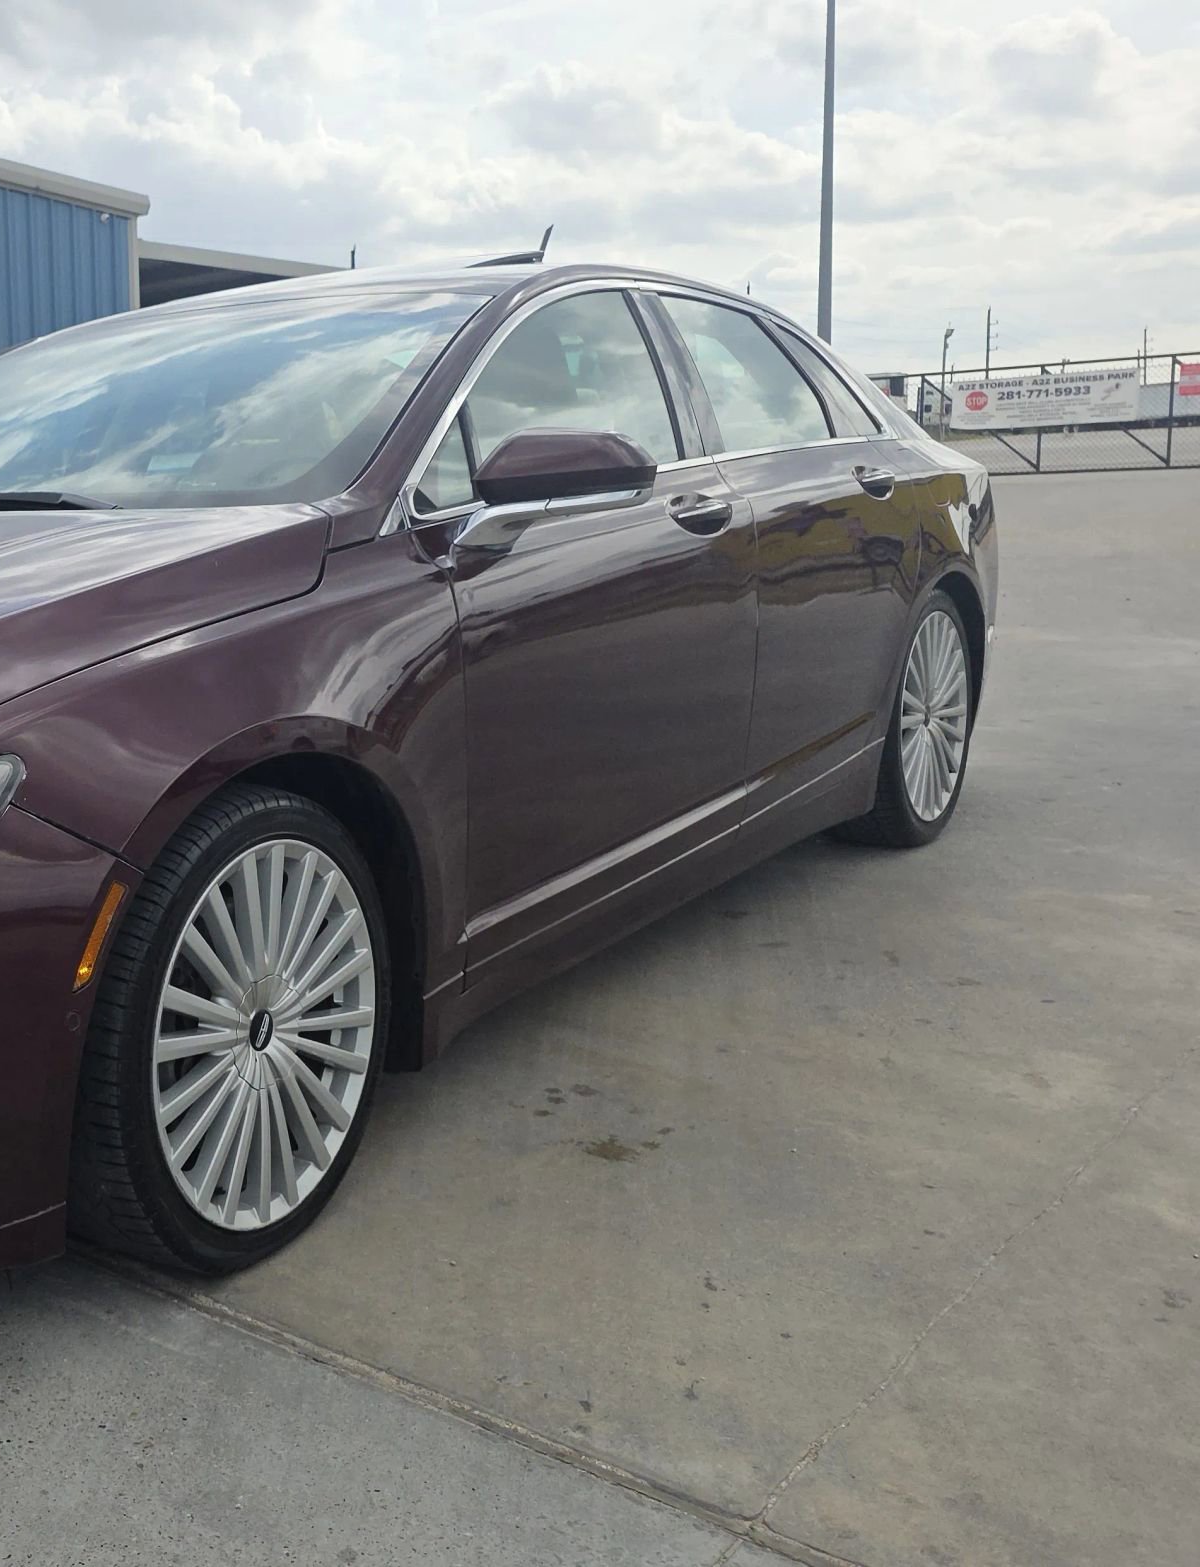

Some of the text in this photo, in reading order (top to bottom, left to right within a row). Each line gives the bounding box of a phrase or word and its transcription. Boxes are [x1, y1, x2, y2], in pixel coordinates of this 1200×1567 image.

[958, 383, 977, 391] A2Z
[979, 380, 1024, 389] STORAGE
[1054, 374, 1105, 384] BUSINESS
[1107, 371, 1136, 381] PARK
[966, 396, 987, 406] STOP
[997, 386, 1091, 401] 281-771-5933
